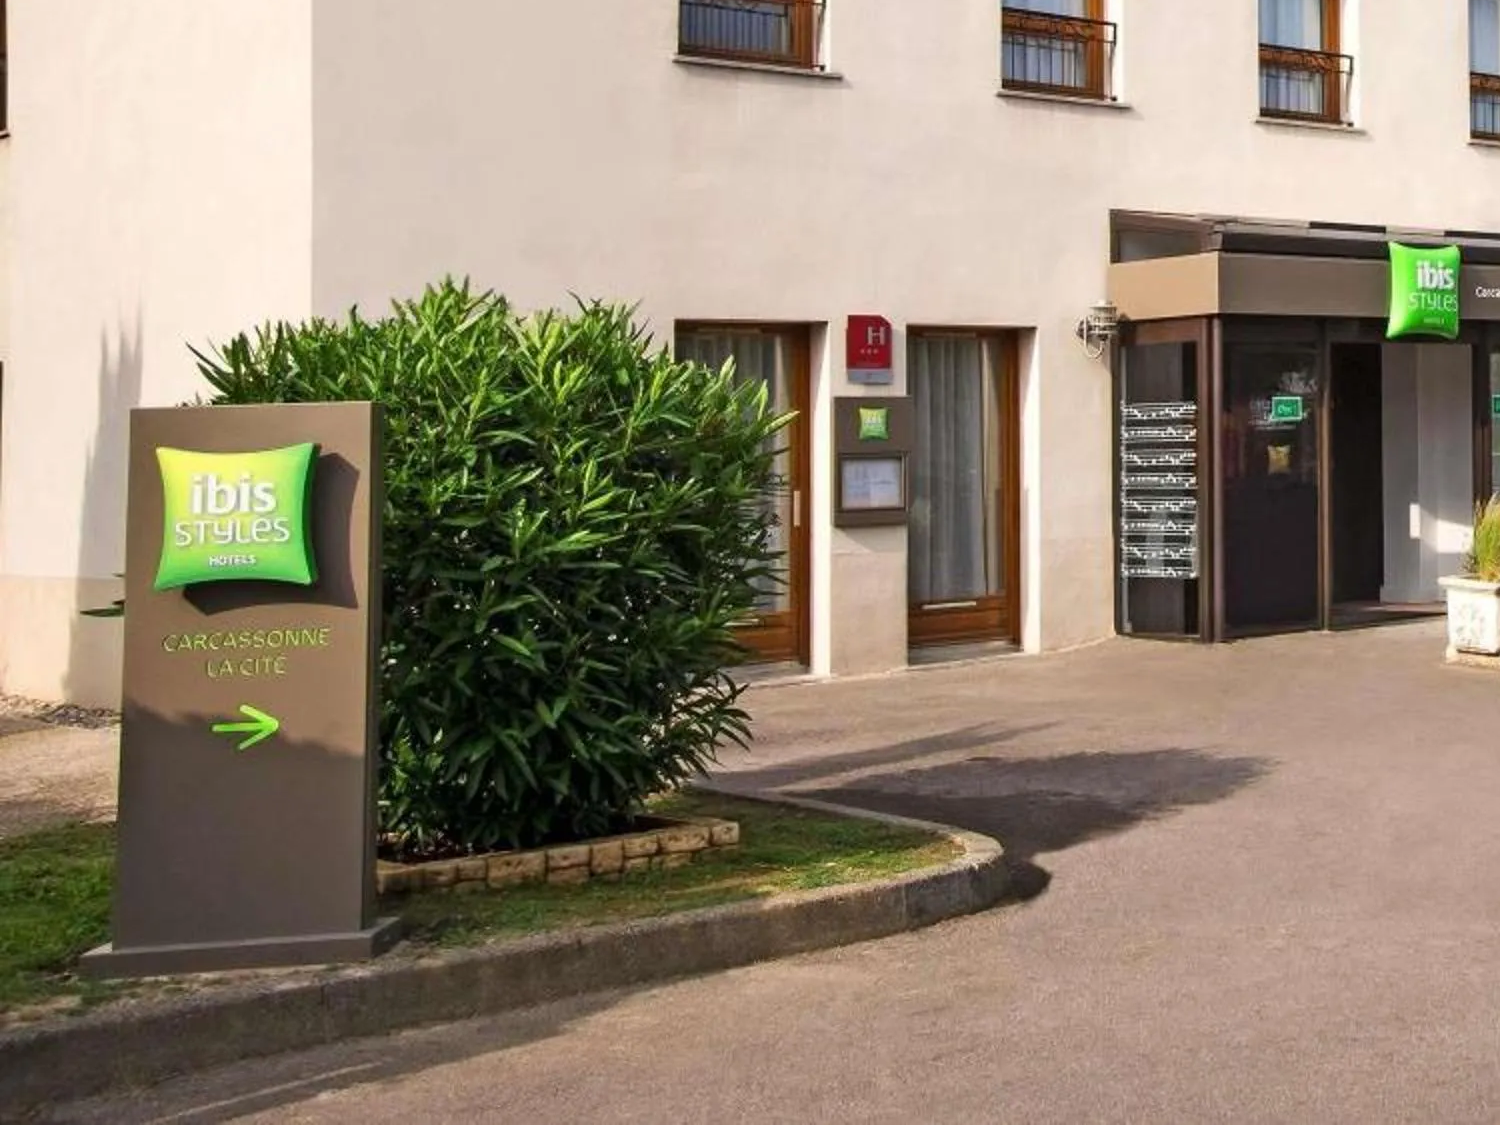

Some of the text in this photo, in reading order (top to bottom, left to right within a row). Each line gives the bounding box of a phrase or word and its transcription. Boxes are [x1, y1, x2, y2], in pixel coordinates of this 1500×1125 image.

[1416, 260, 1455, 290] ibis
[867, 326, 885, 345] H
[191, 472, 276, 515] ibis
[208, 554, 257, 566] HOTELS
[163, 628, 331, 652] CARCASSONNE
[206, 658, 233, 678] LA
